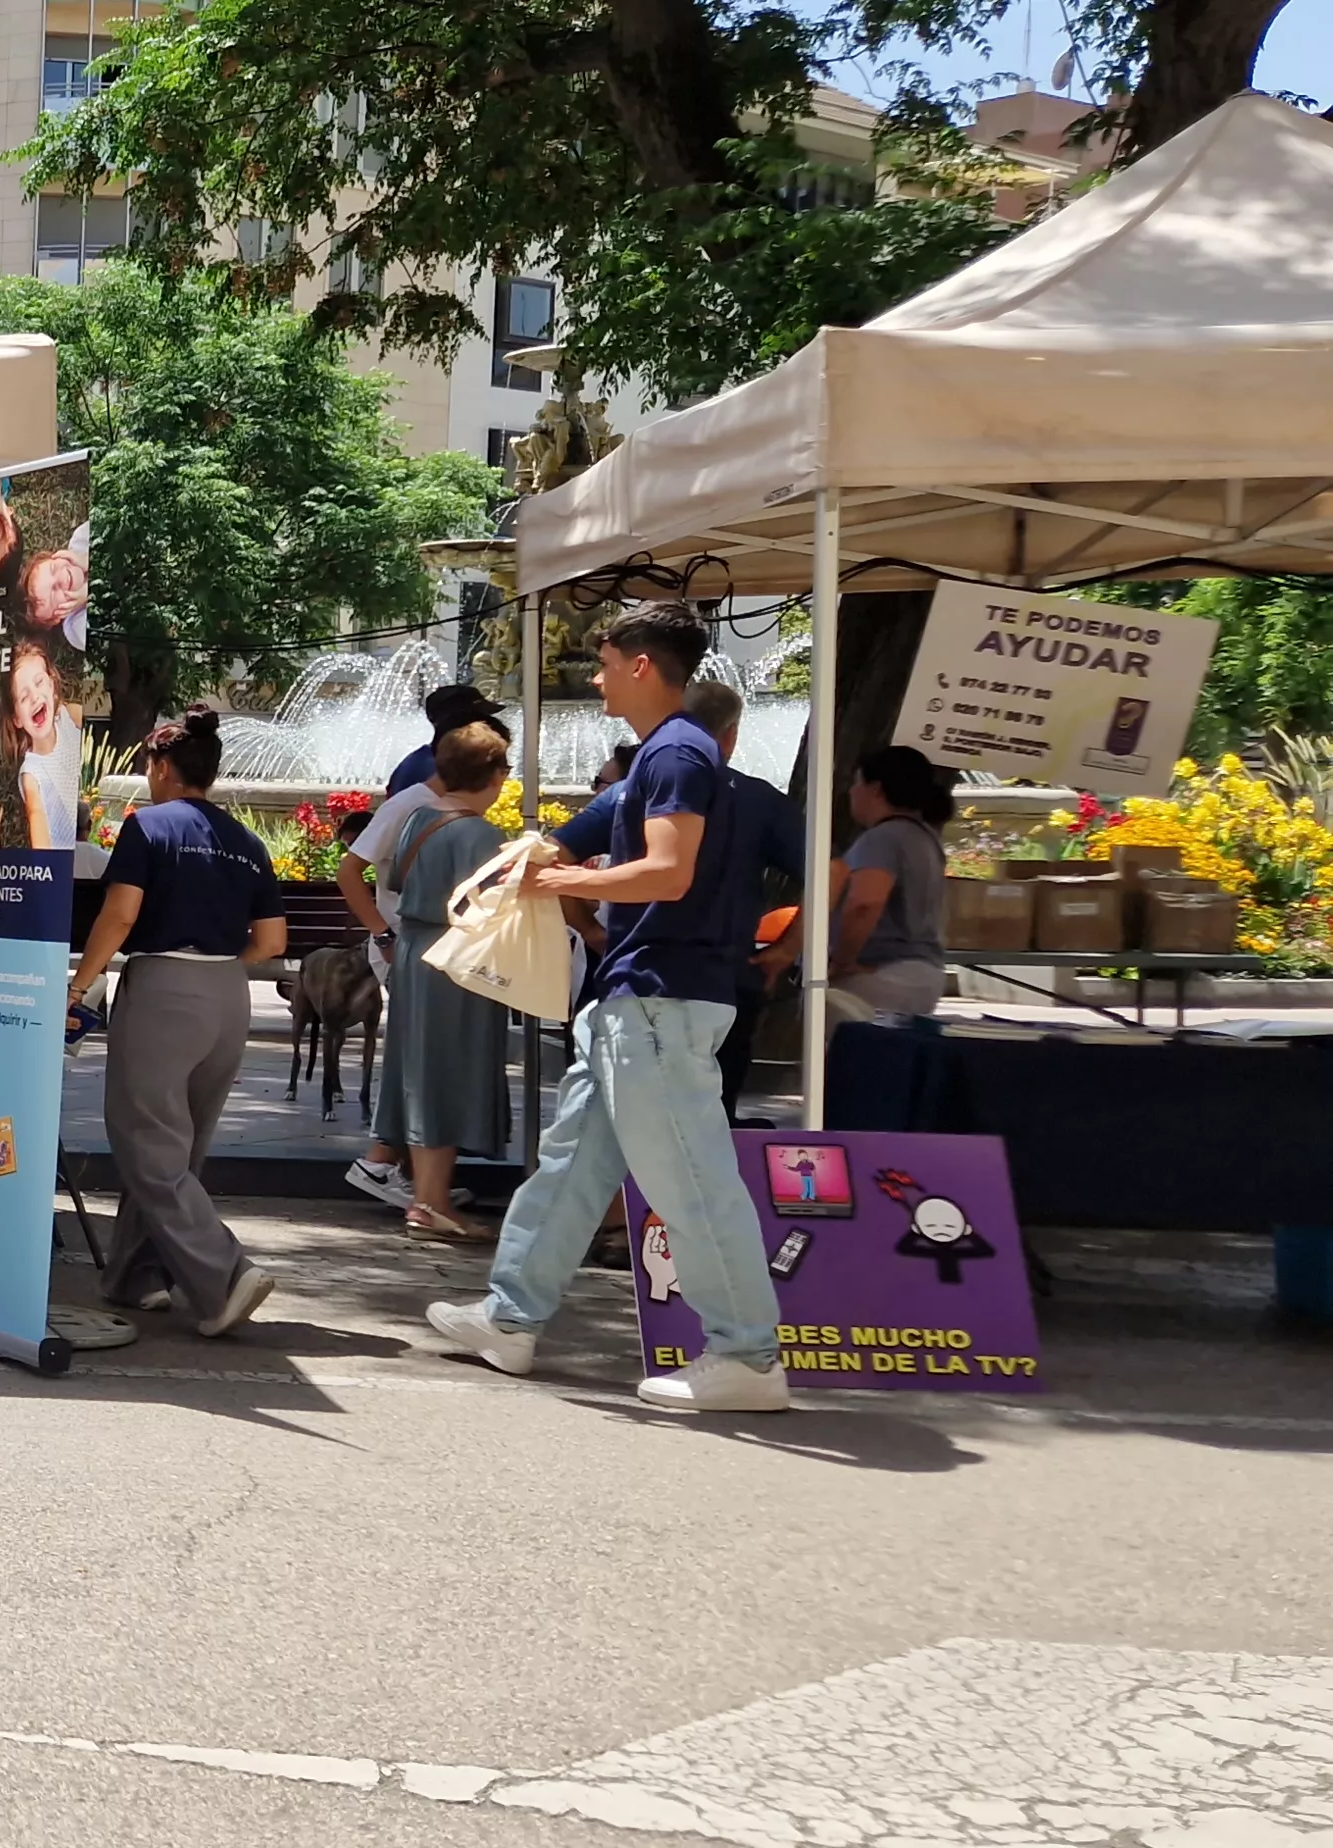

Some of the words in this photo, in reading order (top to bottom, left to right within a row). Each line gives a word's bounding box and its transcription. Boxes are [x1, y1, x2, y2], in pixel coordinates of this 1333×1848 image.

[985, 604, 1020, 624] TE
[1026, 611, 1162, 645] PODEMOS
[974, 630, 1152, 678] AYUDAR
[19, 866, 53, 882] PARA
[22, 1017, 29, 1030] y
[776, 1324, 841, 1346] BES
[851, 1326, 973, 1349] MUCHO
[654, 1346, 692, 1367] EL
[873, 1352, 917, 1374] DE
[925, 1353, 970, 1375] LA
[974, 1355, 1039, 1378] TV?
